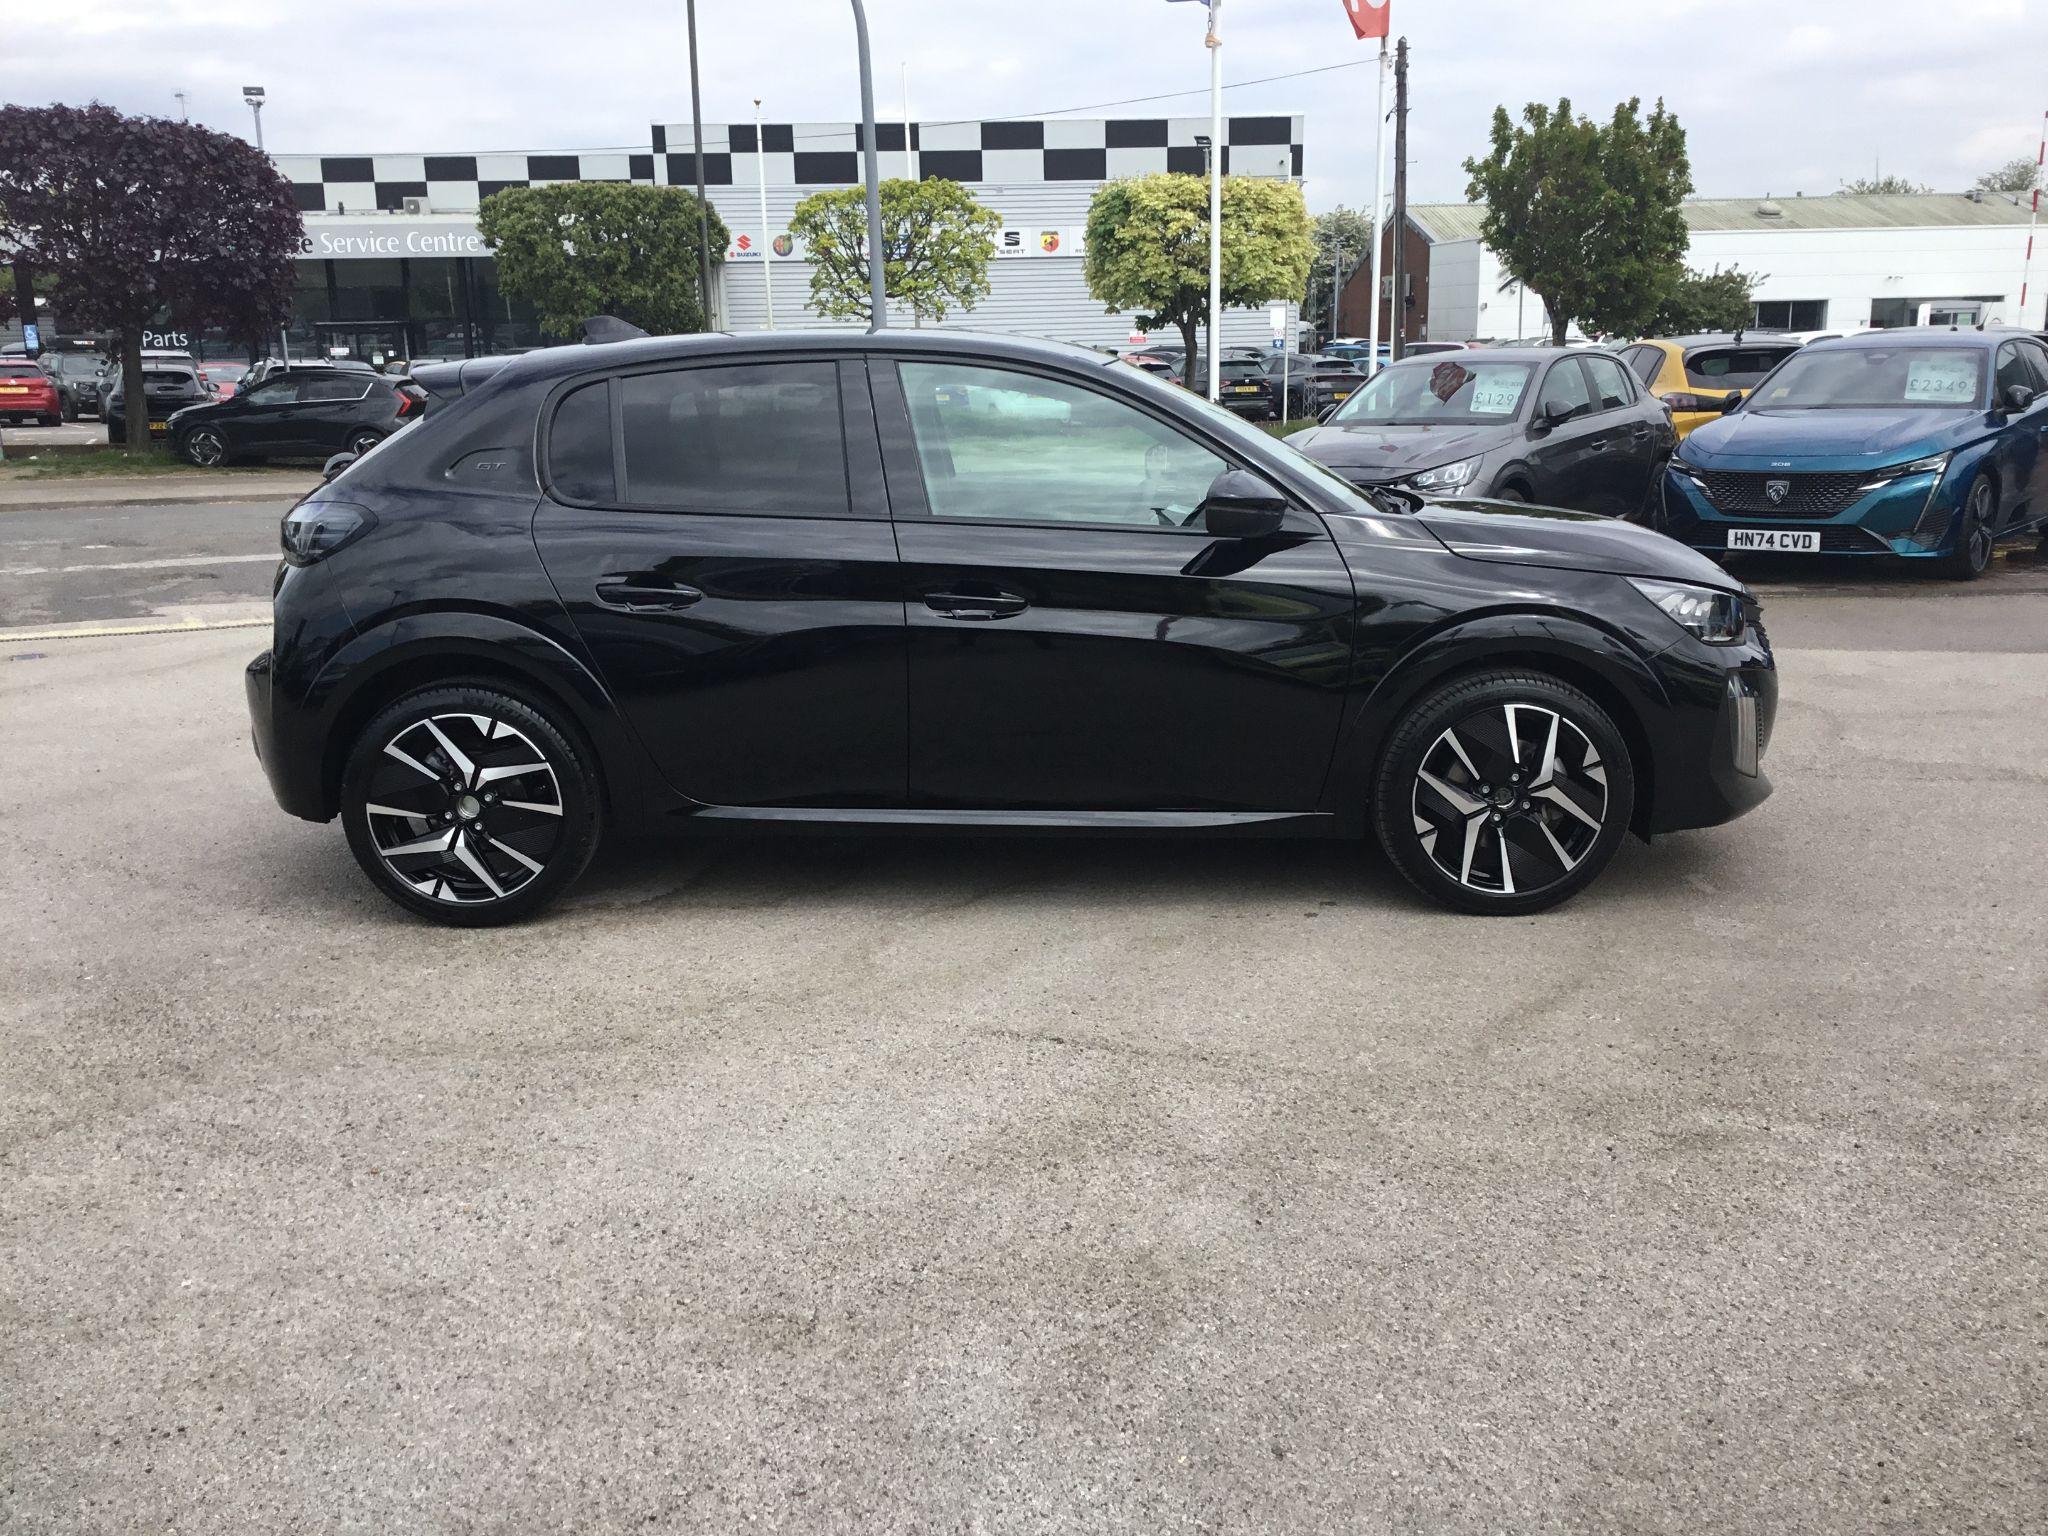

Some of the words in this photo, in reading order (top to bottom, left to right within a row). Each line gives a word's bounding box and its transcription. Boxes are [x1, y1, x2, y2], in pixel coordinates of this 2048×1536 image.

[320, 230, 400, 253] Service
[406, 231, 479, 252] Centre
[142, 330, 188, 347] Parts
[477, 462, 507, 471] GT
[1734, 532, 1775, 547] HN74
[1780, 534, 1812, 549] CVD
